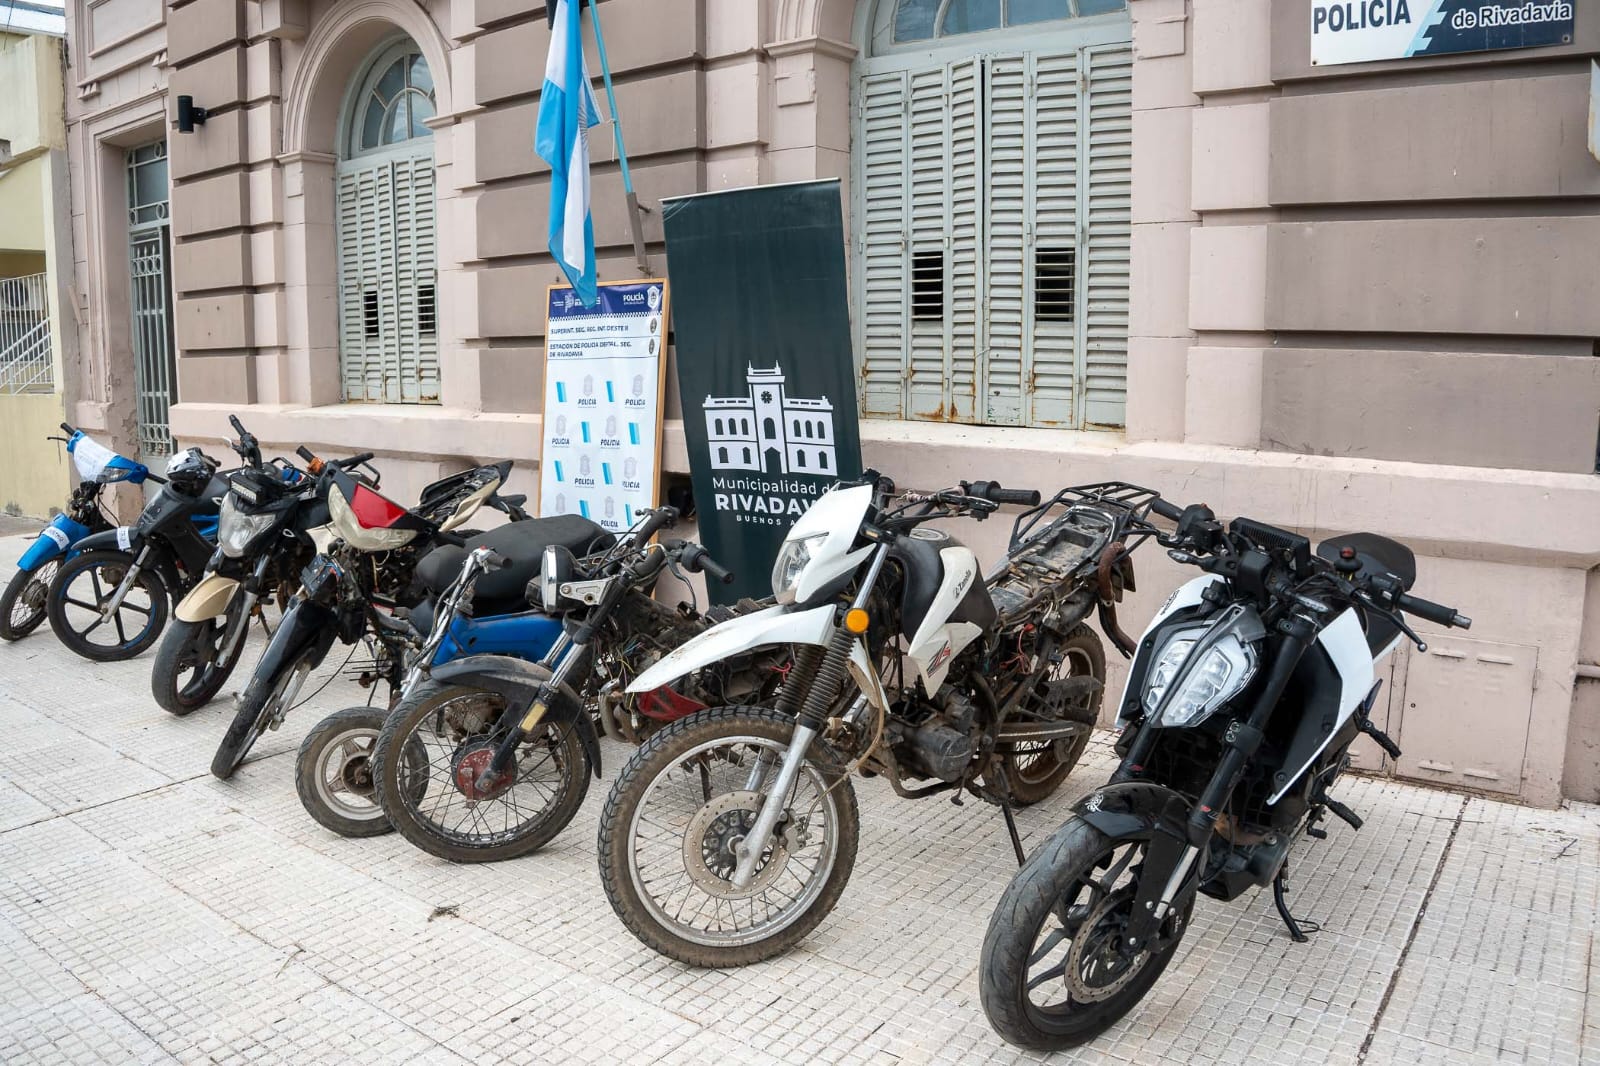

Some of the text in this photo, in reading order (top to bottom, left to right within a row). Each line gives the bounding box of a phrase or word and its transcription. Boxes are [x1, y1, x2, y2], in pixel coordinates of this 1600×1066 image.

[1452, 1, 1572, 29] de Rivadavia
[713, 477, 817, 495] Municipalidad
[715, 494, 818, 516] RIVADAV
[736, 514, 782, 526] BUENOS
